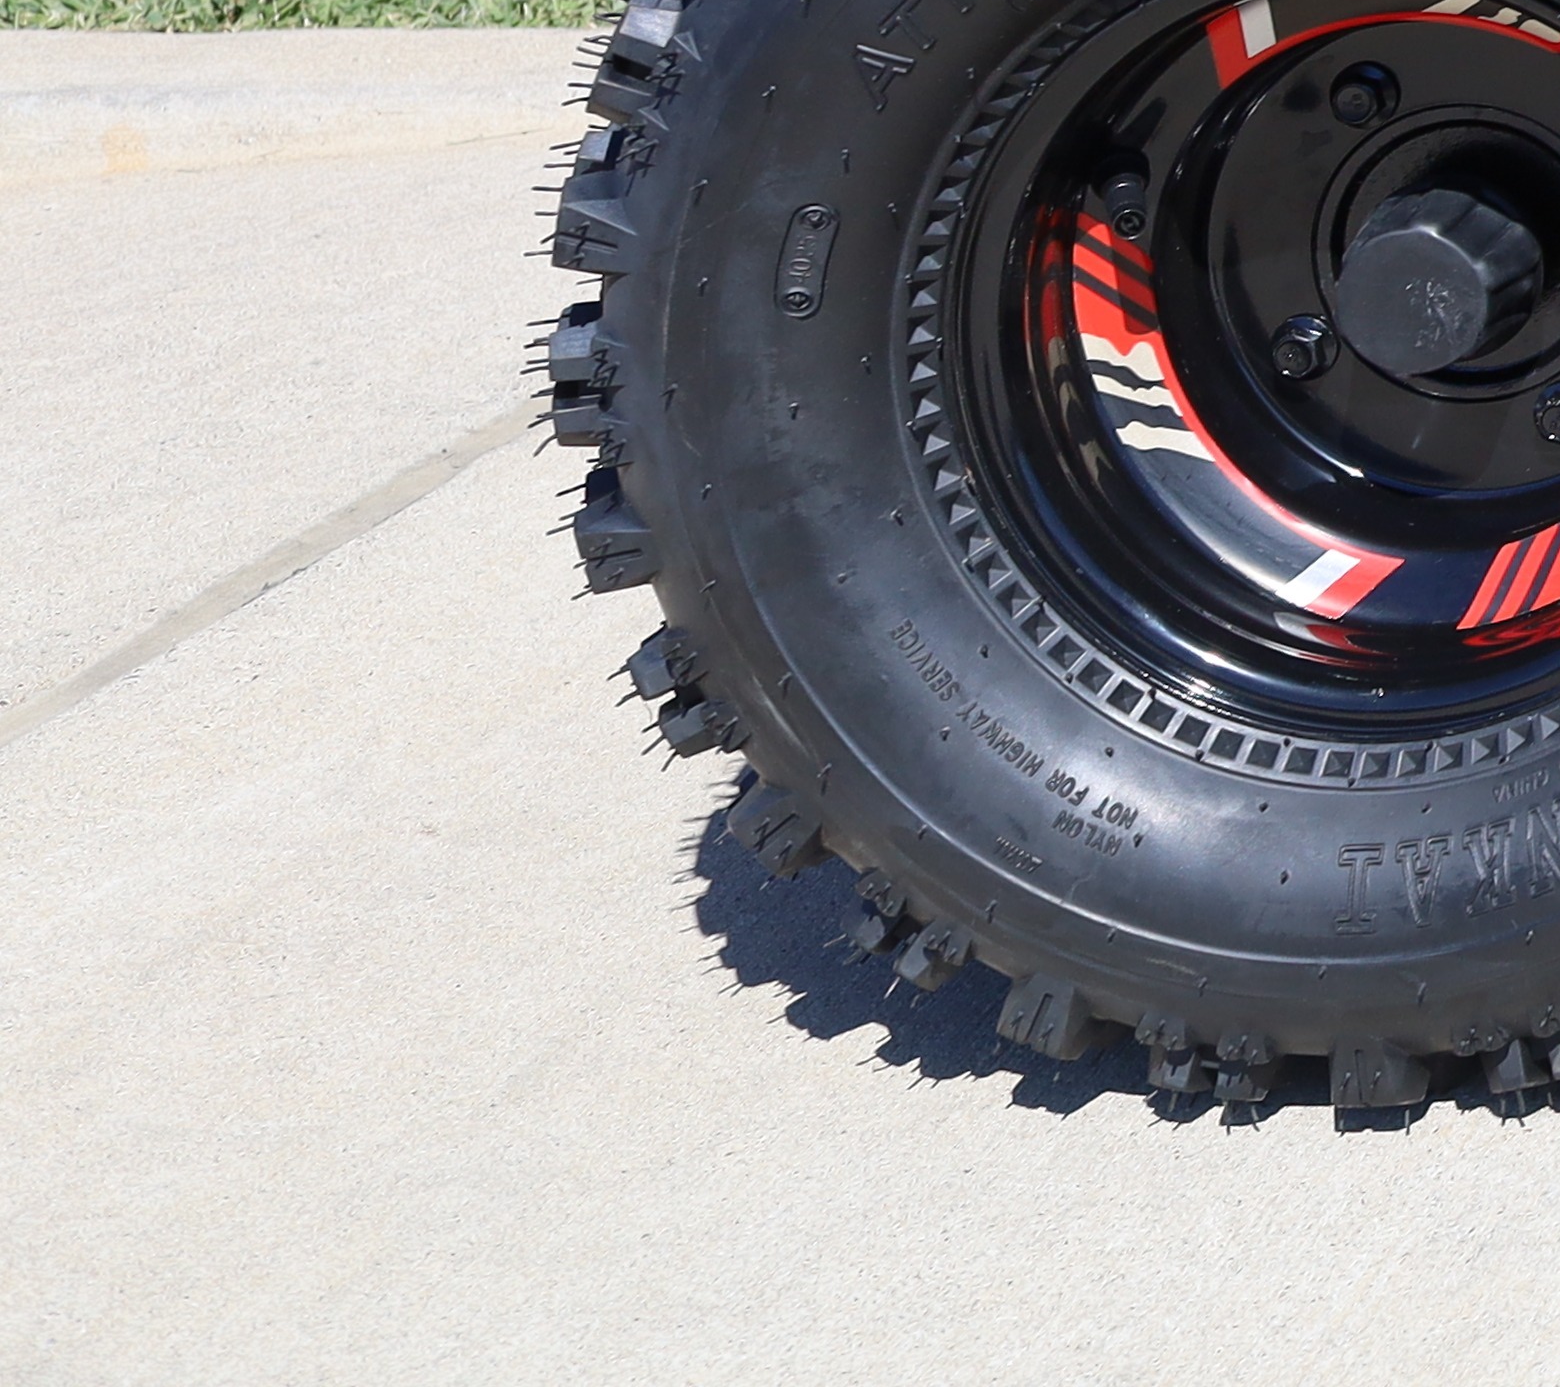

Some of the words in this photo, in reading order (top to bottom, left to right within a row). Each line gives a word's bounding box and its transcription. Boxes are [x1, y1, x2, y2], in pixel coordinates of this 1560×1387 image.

[890, 616, 961, 702] SERVICE
[955, 701, 1046, 778] HIGHWAY
[1044, 768, 1090, 807] FOR
[1052, 809, 1124, 857] NYLON
[1091, 795, 1139, 830] NOT
